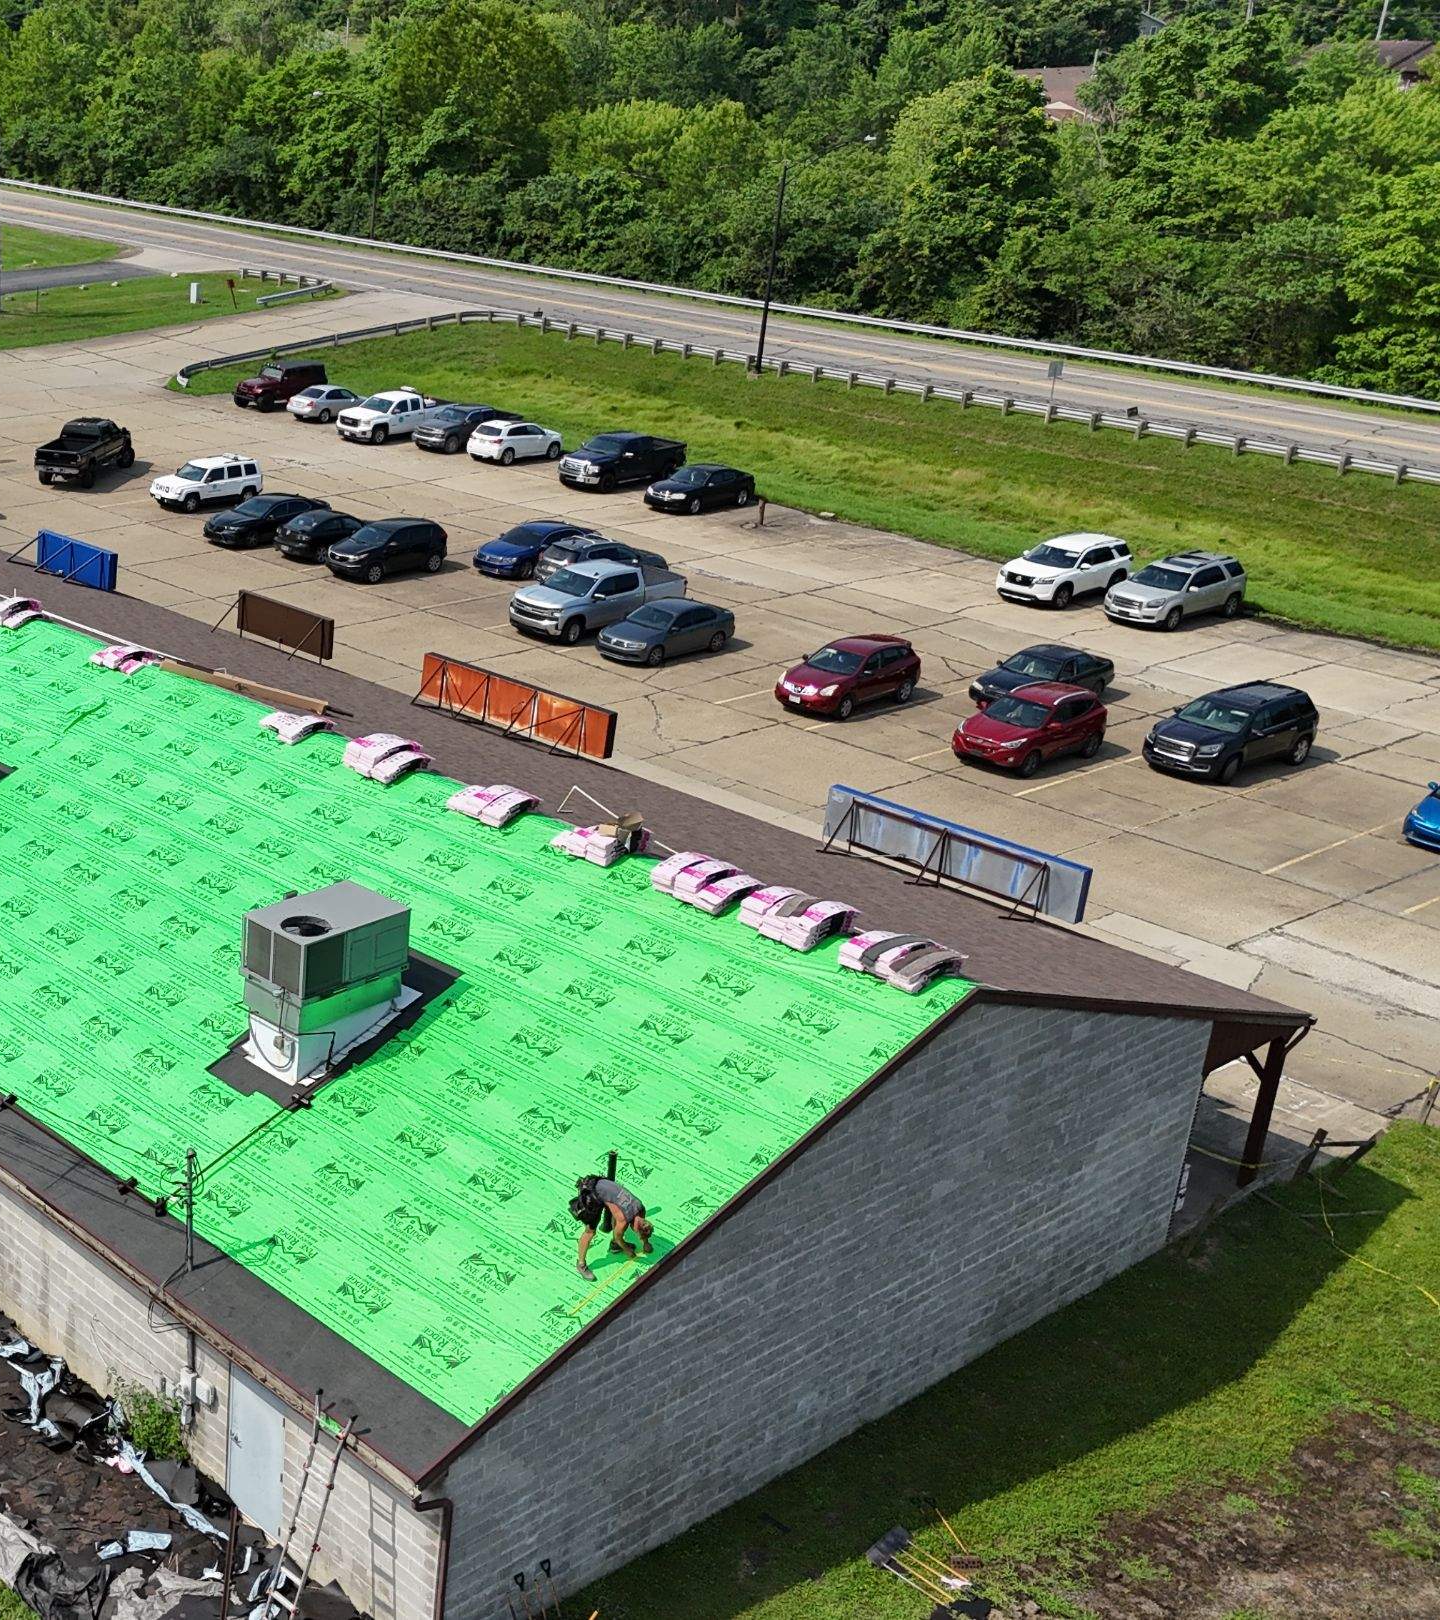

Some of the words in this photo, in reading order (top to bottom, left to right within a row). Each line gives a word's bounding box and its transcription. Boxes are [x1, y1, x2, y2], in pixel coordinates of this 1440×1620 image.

[670, 1101, 700, 1119] RIDGE
[516, 1112, 538, 1127] PINE
[536, 1123, 565, 1141] RIDGE
[698, 1116, 722, 1131] PINE
[474, 1165, 502, 1184] RIDGE
[500, 1180, 522, 1196] PINE
[382, 1211, 404, 1227] PINE
[401, 1223, 430, 1244] RIDGE
[344, 1273, 372, 1295] RIDGE
[457, 1258, 480, 1276] PINE
[478, 1272, 509, 1294] RIDGE
[370, 1291, 392, 1309] PINE
[539, 1311, 562, 1328] PINE
[420, 1325, 450, 1348] RIDGE
[447, 1344, 471, 1363] PINE
